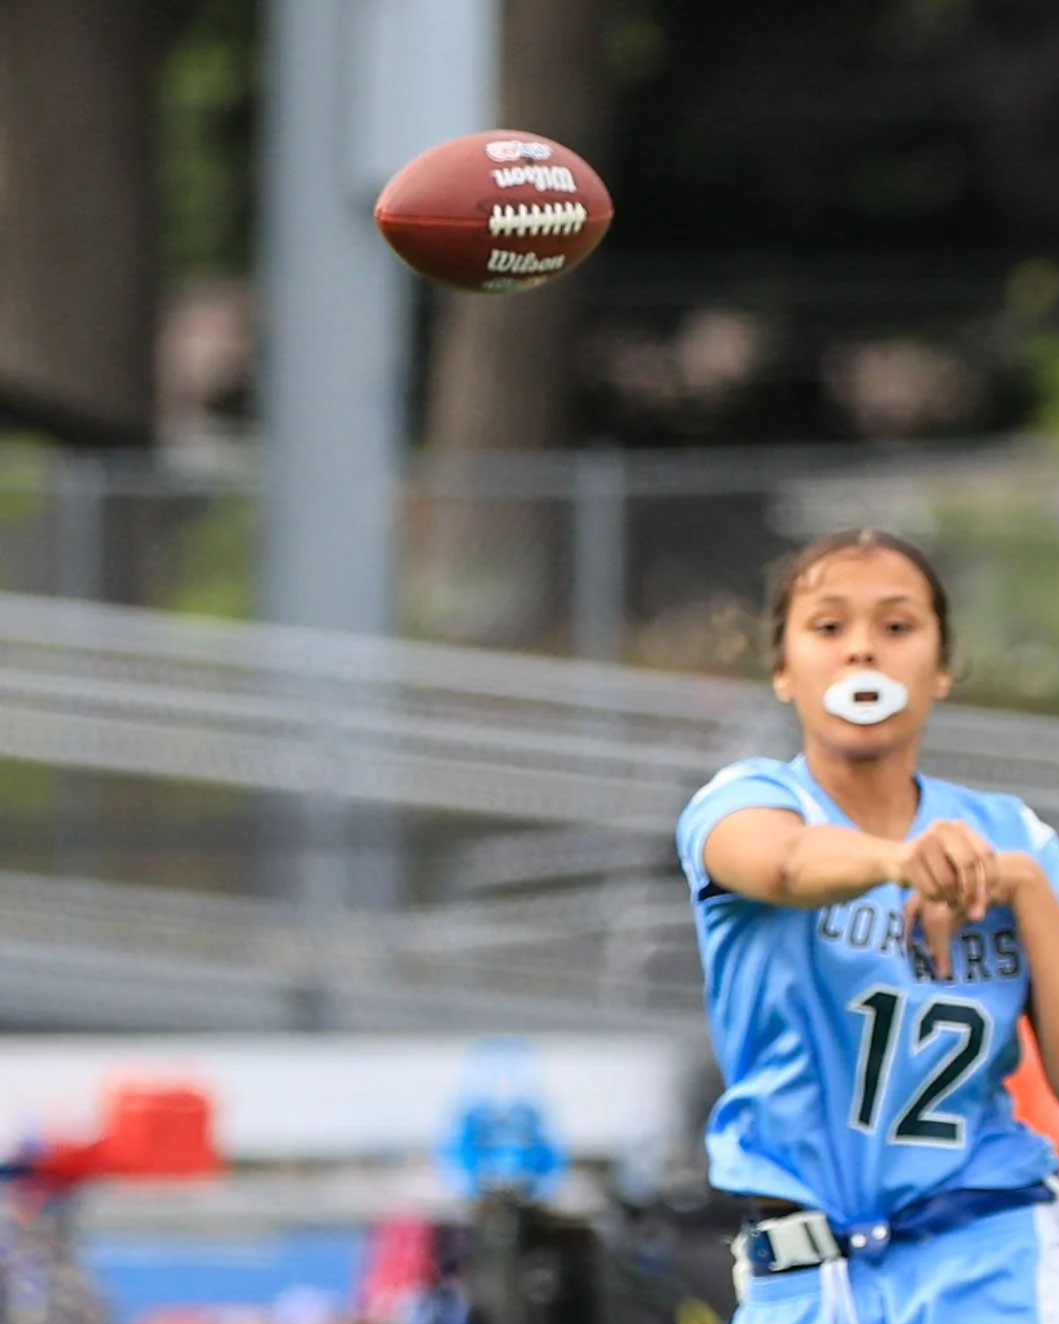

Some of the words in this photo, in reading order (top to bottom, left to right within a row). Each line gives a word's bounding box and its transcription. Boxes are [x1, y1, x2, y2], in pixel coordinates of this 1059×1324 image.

[490, 165, 577, 193] Wilson
[487, 249, 566, 274] Wilson
[849, 985, 993, 1148] 12
